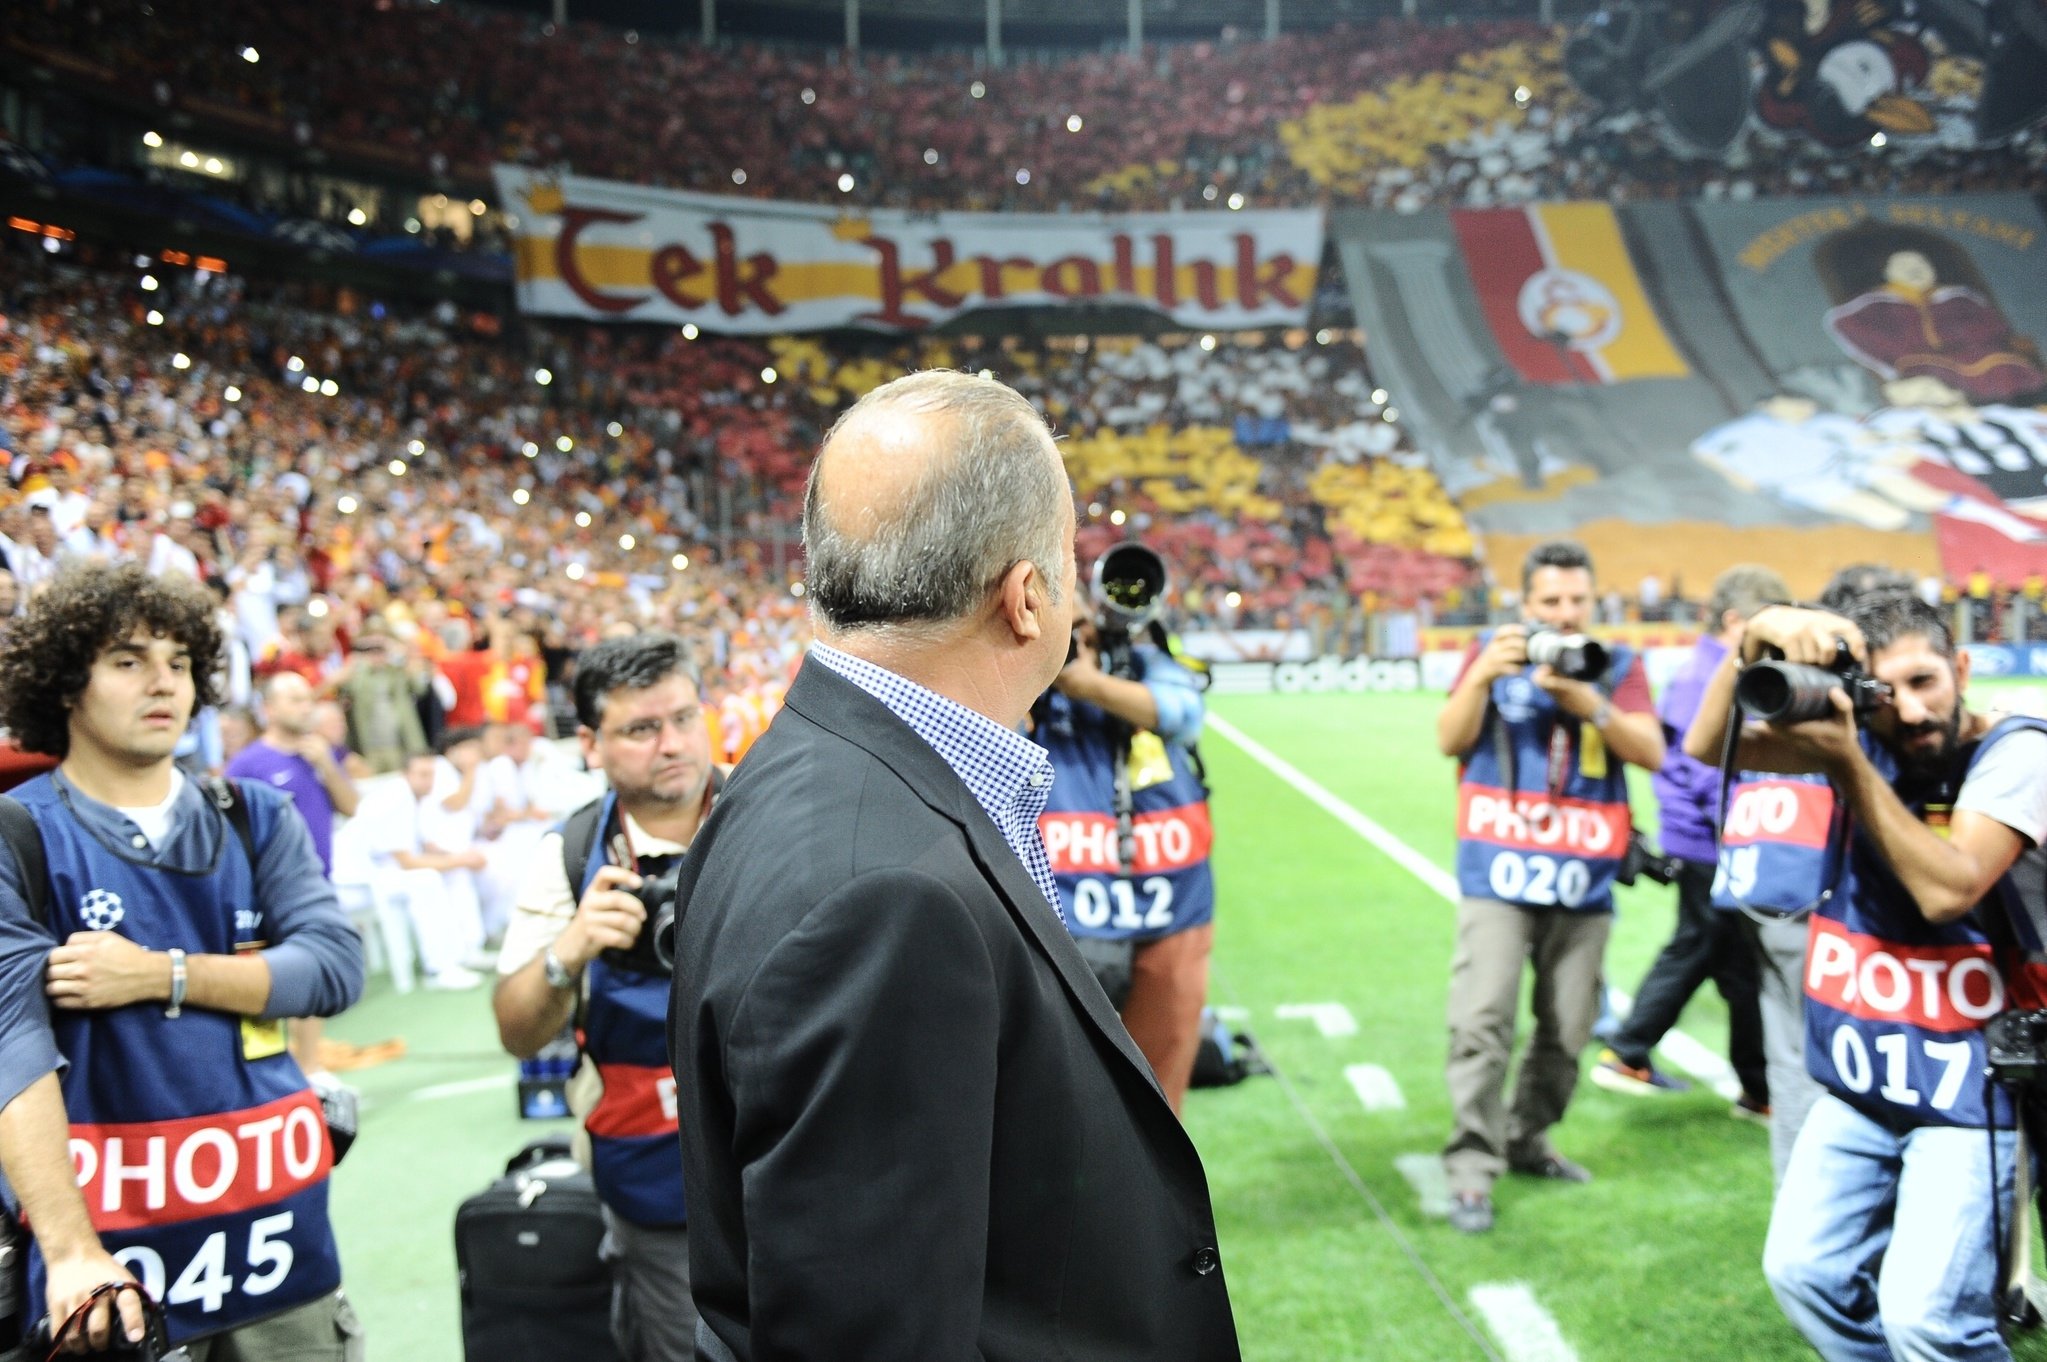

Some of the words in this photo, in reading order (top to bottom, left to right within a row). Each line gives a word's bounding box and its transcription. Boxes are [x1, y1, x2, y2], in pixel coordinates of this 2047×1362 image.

[557, 203, 787, 316] Tek
[1274, 652, 1418, 693] adidas
[1045, 818, 1191, 866] PHOTO
[1468, 795, 1612, 852] PHOTO
[1073, 876, 1174, 929] 012
[1489, 851, 1590, 908] 020
[1832, 1024, 1972, 1110] 017
[112, 1211, 294, 1313] 045
